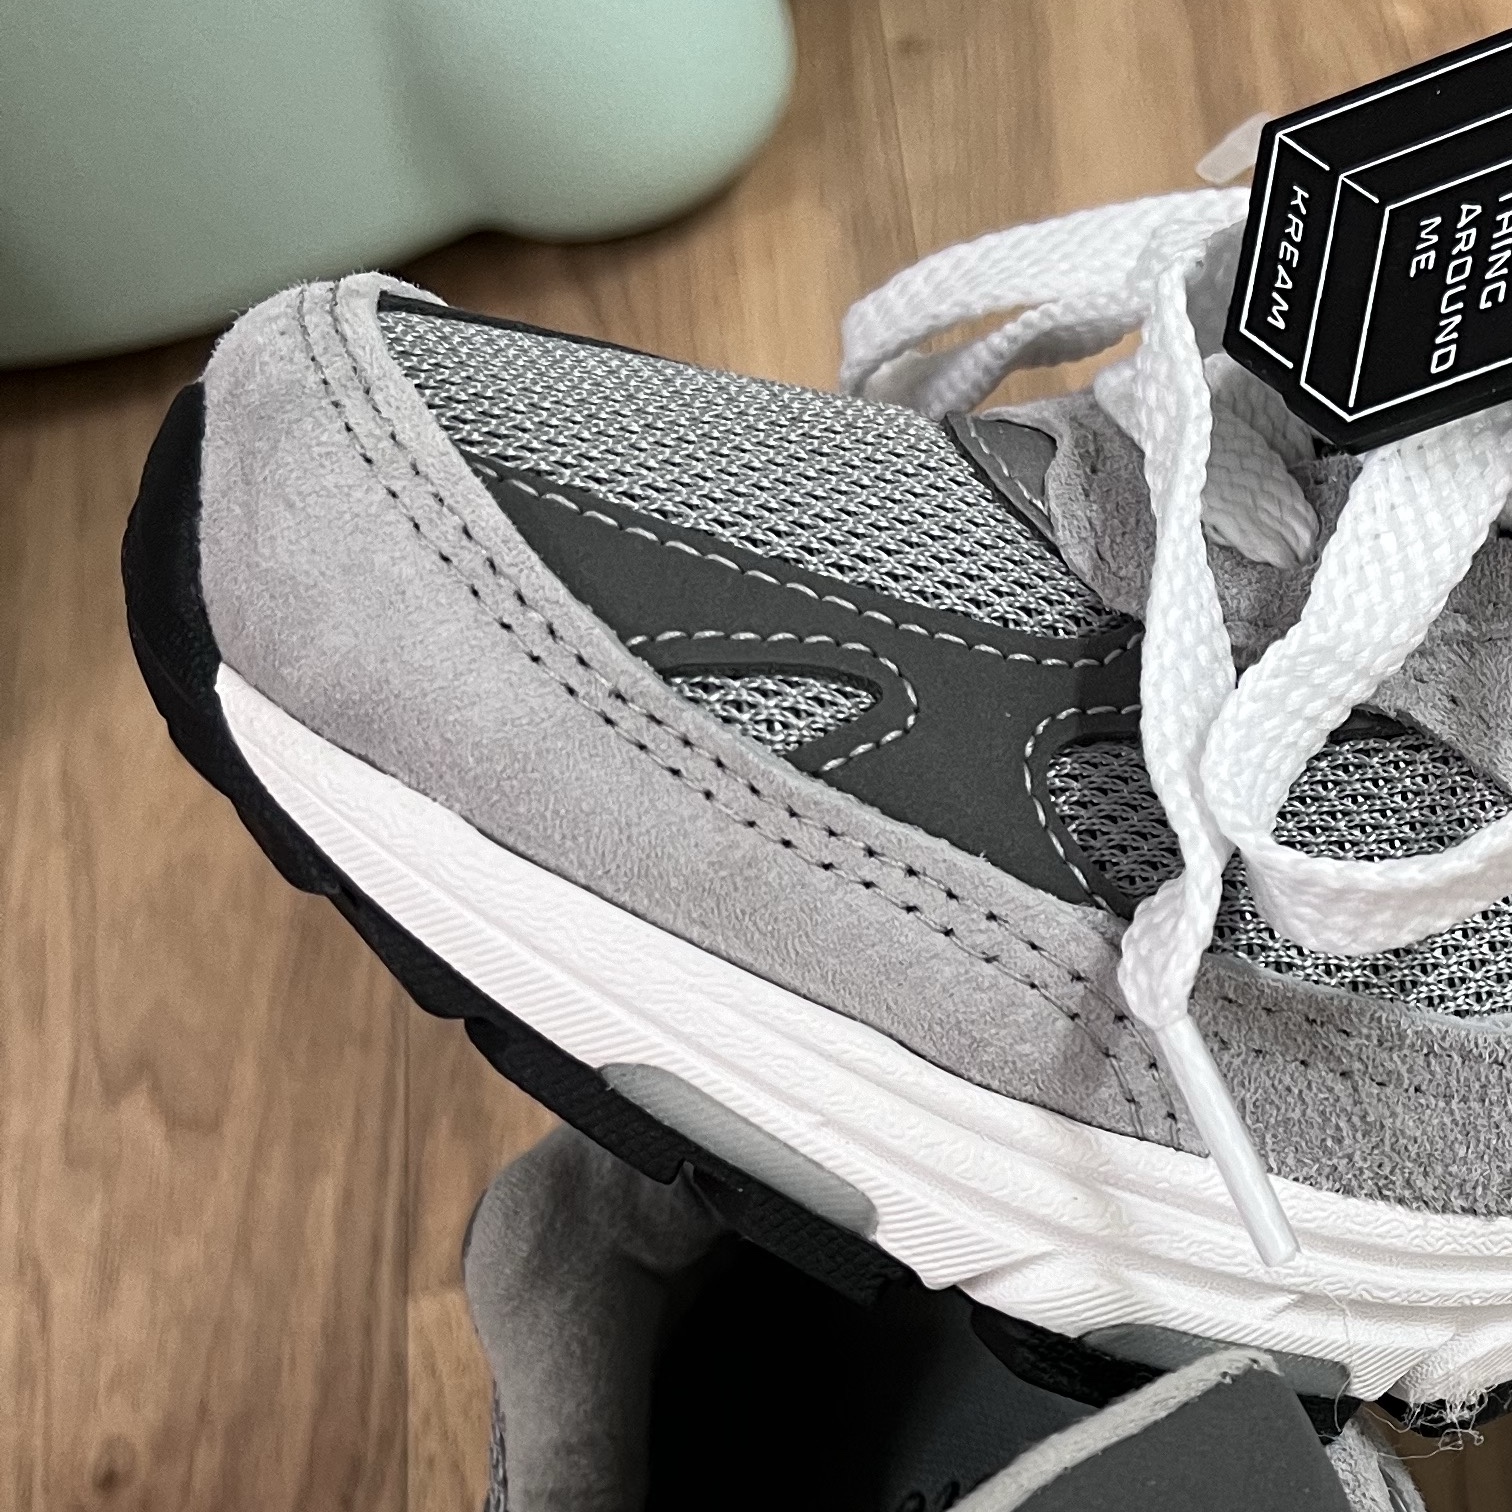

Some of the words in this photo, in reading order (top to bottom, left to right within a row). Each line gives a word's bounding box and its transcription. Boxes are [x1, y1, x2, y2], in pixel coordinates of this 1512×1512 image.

[1265, 185, 1310, 329] KREAM
[1409, 215, 1443, 279] ME
[1430, 203, 1482, 375] AROUND
